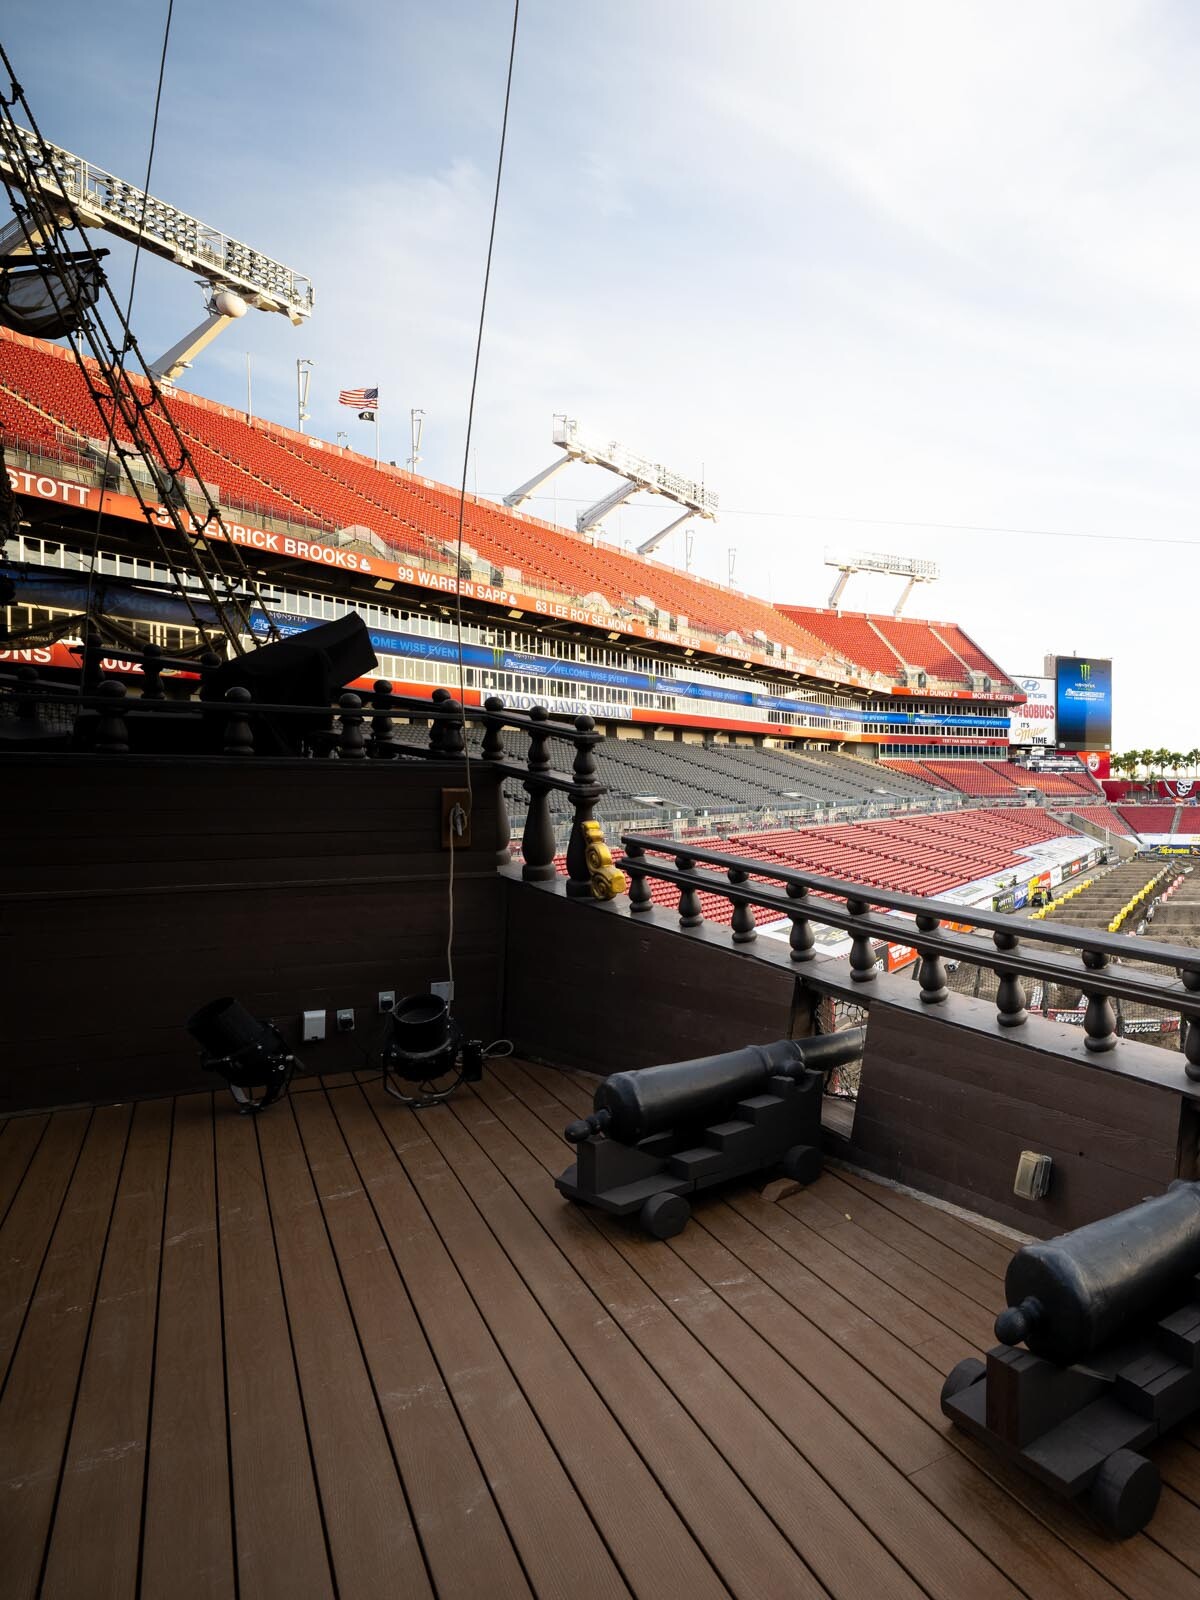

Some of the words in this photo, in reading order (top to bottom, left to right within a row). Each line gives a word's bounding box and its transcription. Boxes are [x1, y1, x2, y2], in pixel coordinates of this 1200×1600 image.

[284, 538, 358, 569] BROOKS
[398, 566, 414, 582] 99
[417, 569, 475, 597] WARREN
[476, 585, 508, 604] SAPP
[269, 611, 307, 624] MONSTER
[535, 600, 547, 612] 63
[549, 603, 569, 618] LEE
[570, 608, 591, 623] ROY
[591, 614, 627, 633] SELMON
[681, 636, 701, 649] GILES
[399, 641, 426, 654] WISE
[428, 645, 461, 660] EVENT
[554, 665, 590, 680] WELCOME
[910, 688, 928, 697] TONY
[930, 689, 953, 698] DUNGY
[972, 692, 994, 701] MONTE
[551, 699, 588, 715] JAMES
[589, 704, 633, 720] STADIUM
[1032, 736, 1047, 745] TIME
